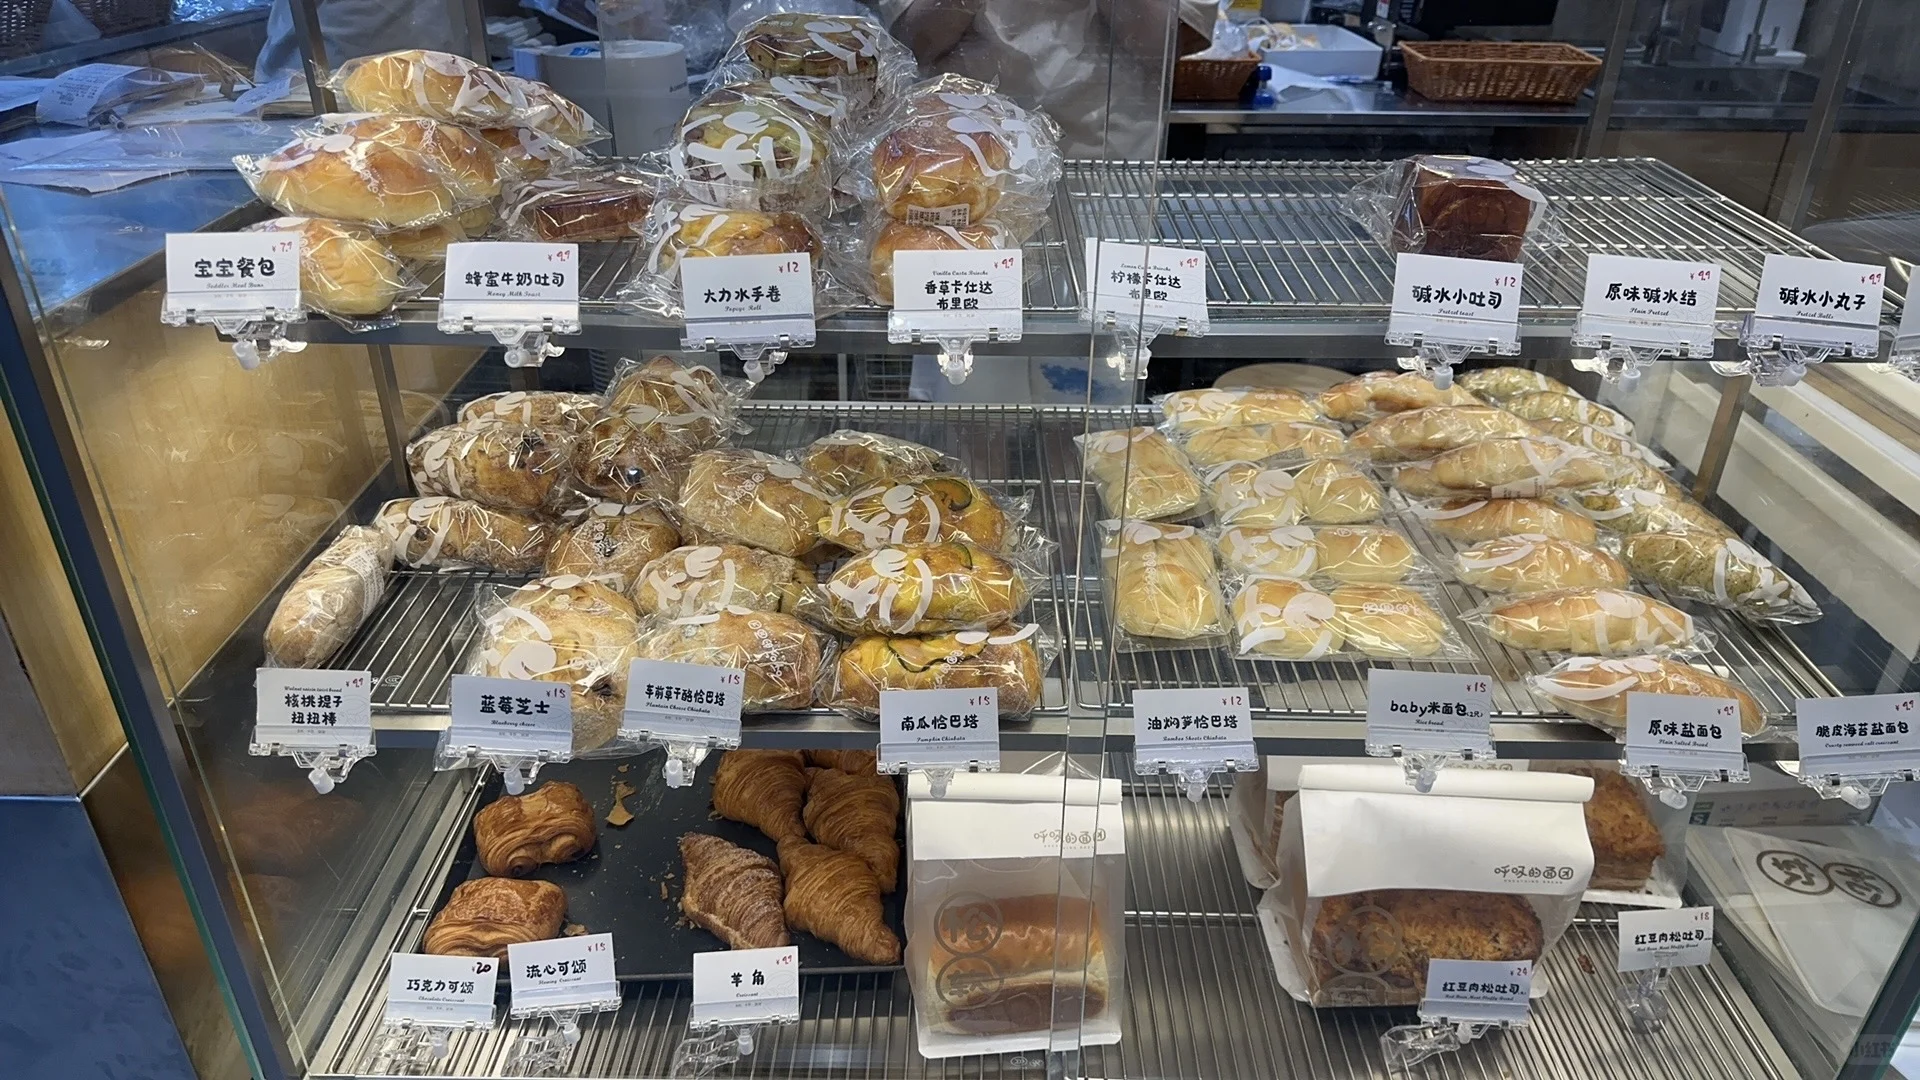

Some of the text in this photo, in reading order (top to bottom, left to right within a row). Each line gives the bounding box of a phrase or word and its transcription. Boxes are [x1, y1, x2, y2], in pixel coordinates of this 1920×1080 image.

[195, 257, 275, 278] 宝宝餐包
[465, 271, 564, 287] 蜂蜜牛奶吐司
[1111, 270, 1181, 288] 柠檬卡仕达
[704, 285, 781, 303] 大力水手卷
[925, 280, 993, 295] 香草卡仕达
[1129, 288, 1168, 301] 布里欧
[1605, 282, 1697, 306] 原味碱水结
[937, 297, 979, 310] 布里欧
[1412, 285, 1502, 309] 碱水小吐司
[1779, 287, 1866, 311] 碱水小丸子
[1648, 308, 1669, 316] Pretzel
[1796, 310, 1816, 318] Pretzel
[285, 694, 342, 708] 核桃提子
[645, 683, 725, 706] 车前草干酪恰巴塔
[480, 695, 550, 715] 蓝莓芝士
[291, 712, 337, 726] 扭扭棒
[901, 714, 979, 731] 南瓜恰巴塔
[1148, 715, 1238, 730] 油焖笋恰巴塔
[1648, 720, 1722, 739] 原味盐面包
[1816, 721, 1909, 738] 脆皮海苔盐面包
[1494, 865, 1574, 880] 呼吸的面团
[1635, 929, 1704, 945] 红豆肉松吐司
[526, 959, 587, 978] 流心可颂
[407, 979, 474, 994] 巧克力可颂
[1442, 982, 1520, 995] 红豆肉松吐司
